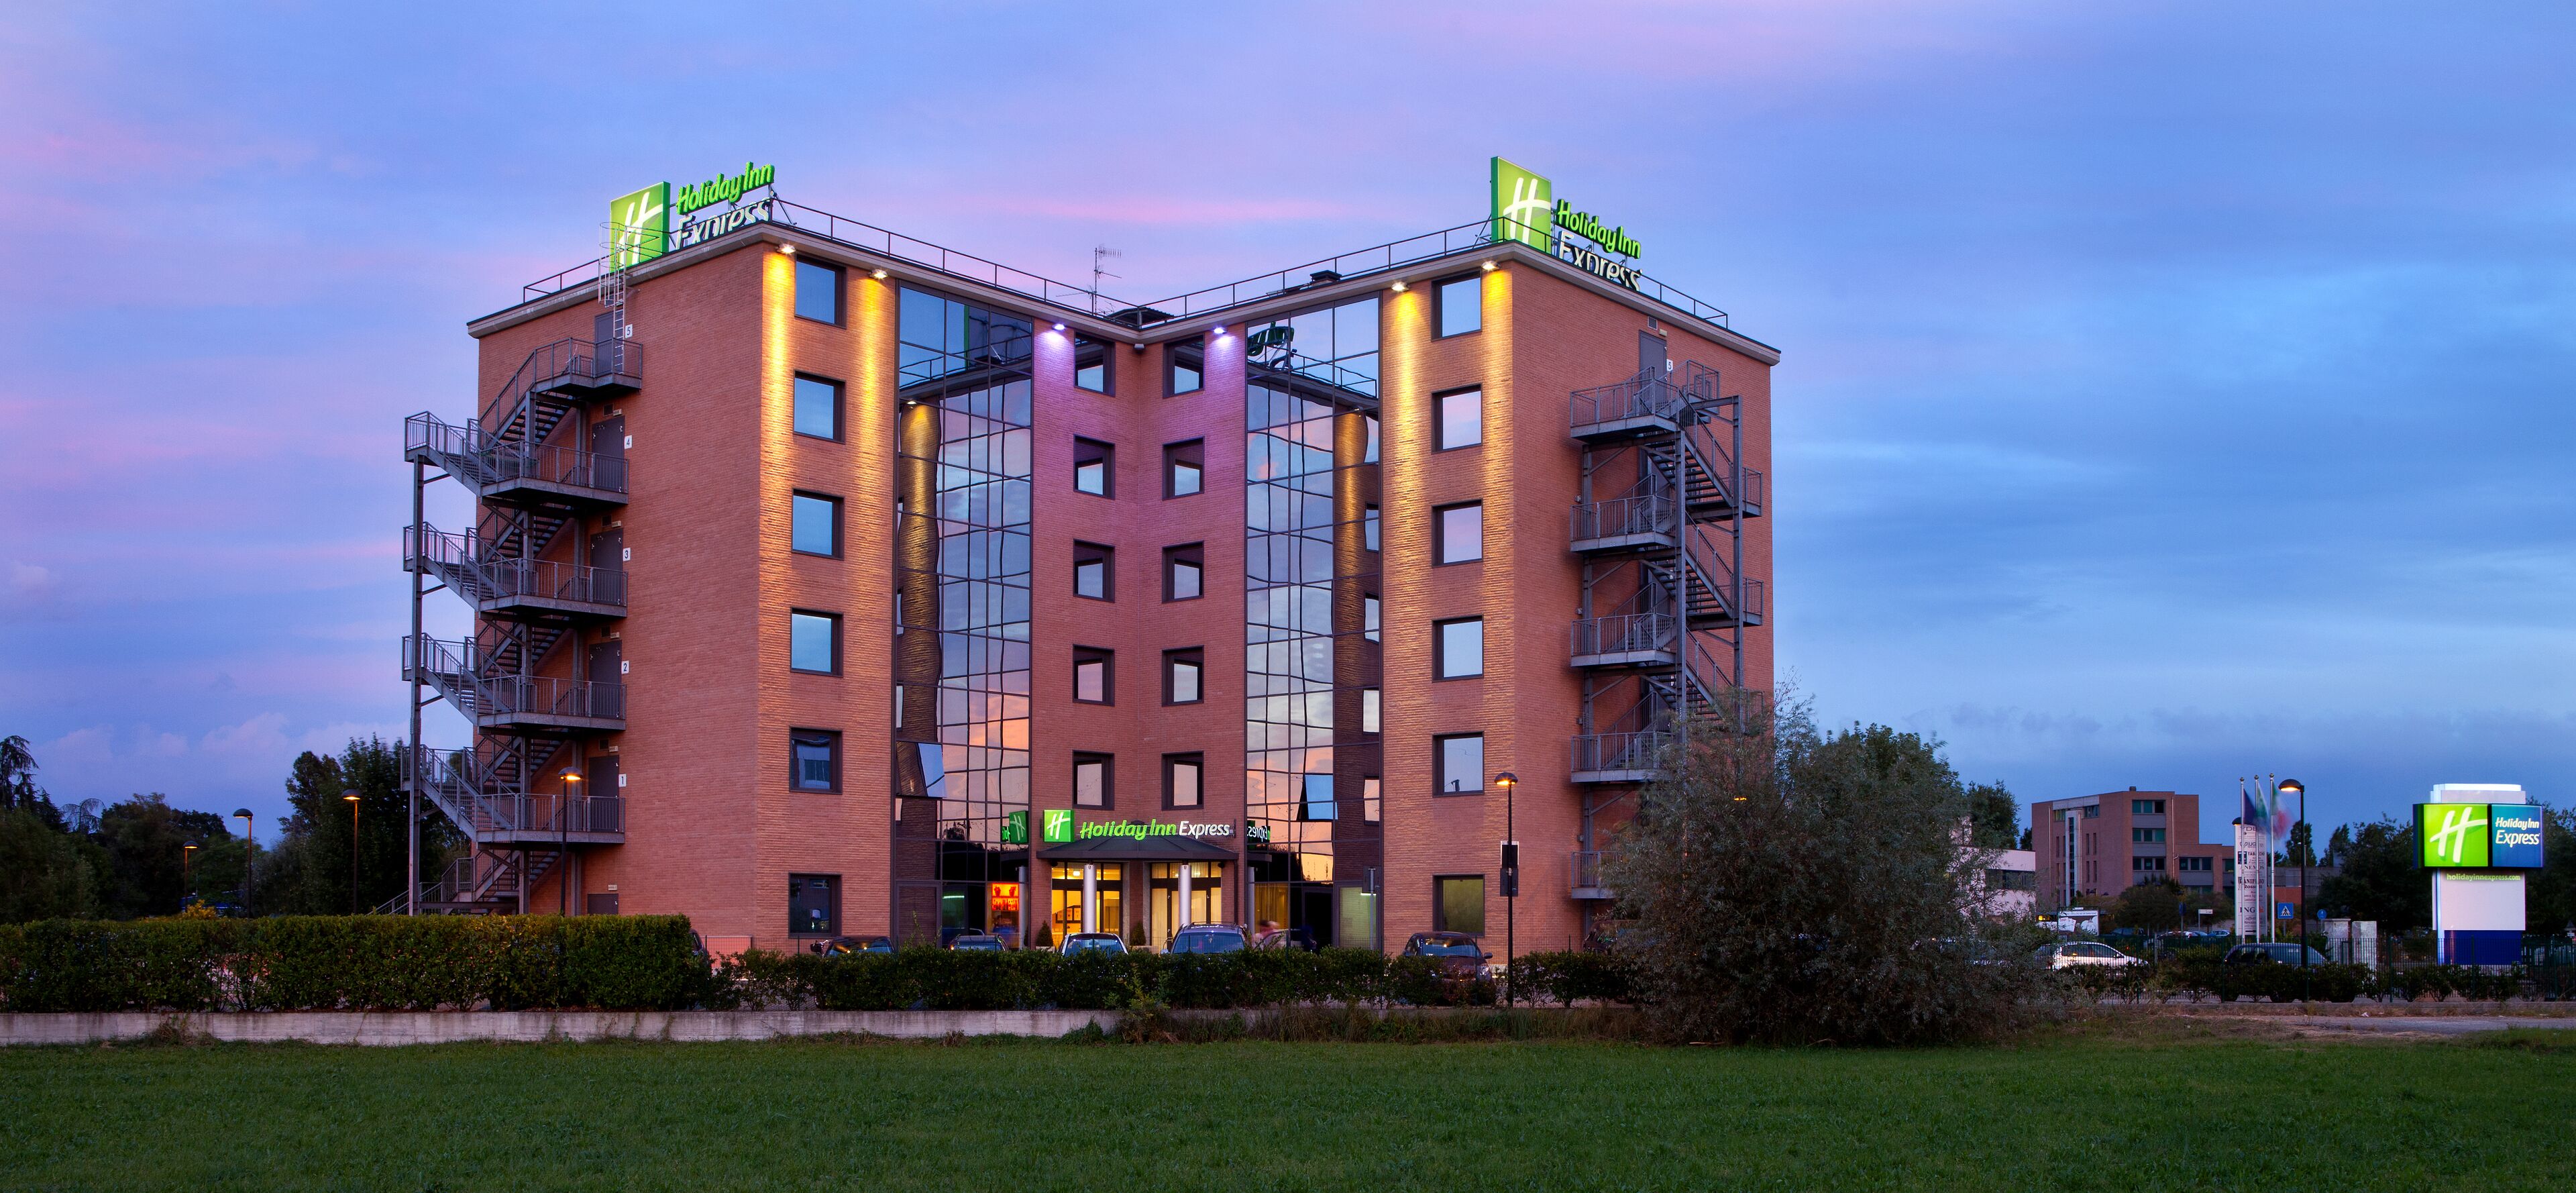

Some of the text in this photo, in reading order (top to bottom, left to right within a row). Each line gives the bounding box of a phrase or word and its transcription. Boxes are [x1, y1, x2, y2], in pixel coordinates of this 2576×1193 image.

[676, 161, 775, 215] Holiday Inn
[1557, 199, 1641, 259] Holiday Inn
[1080, 819, 1230, 840] Holiday Inn Express
[2495, 817, 2539, 830] Holiday Inn
[2496, 829, 2540, 847] Express
[2447, 873, 2521, 882] holidayinnexpress.com
